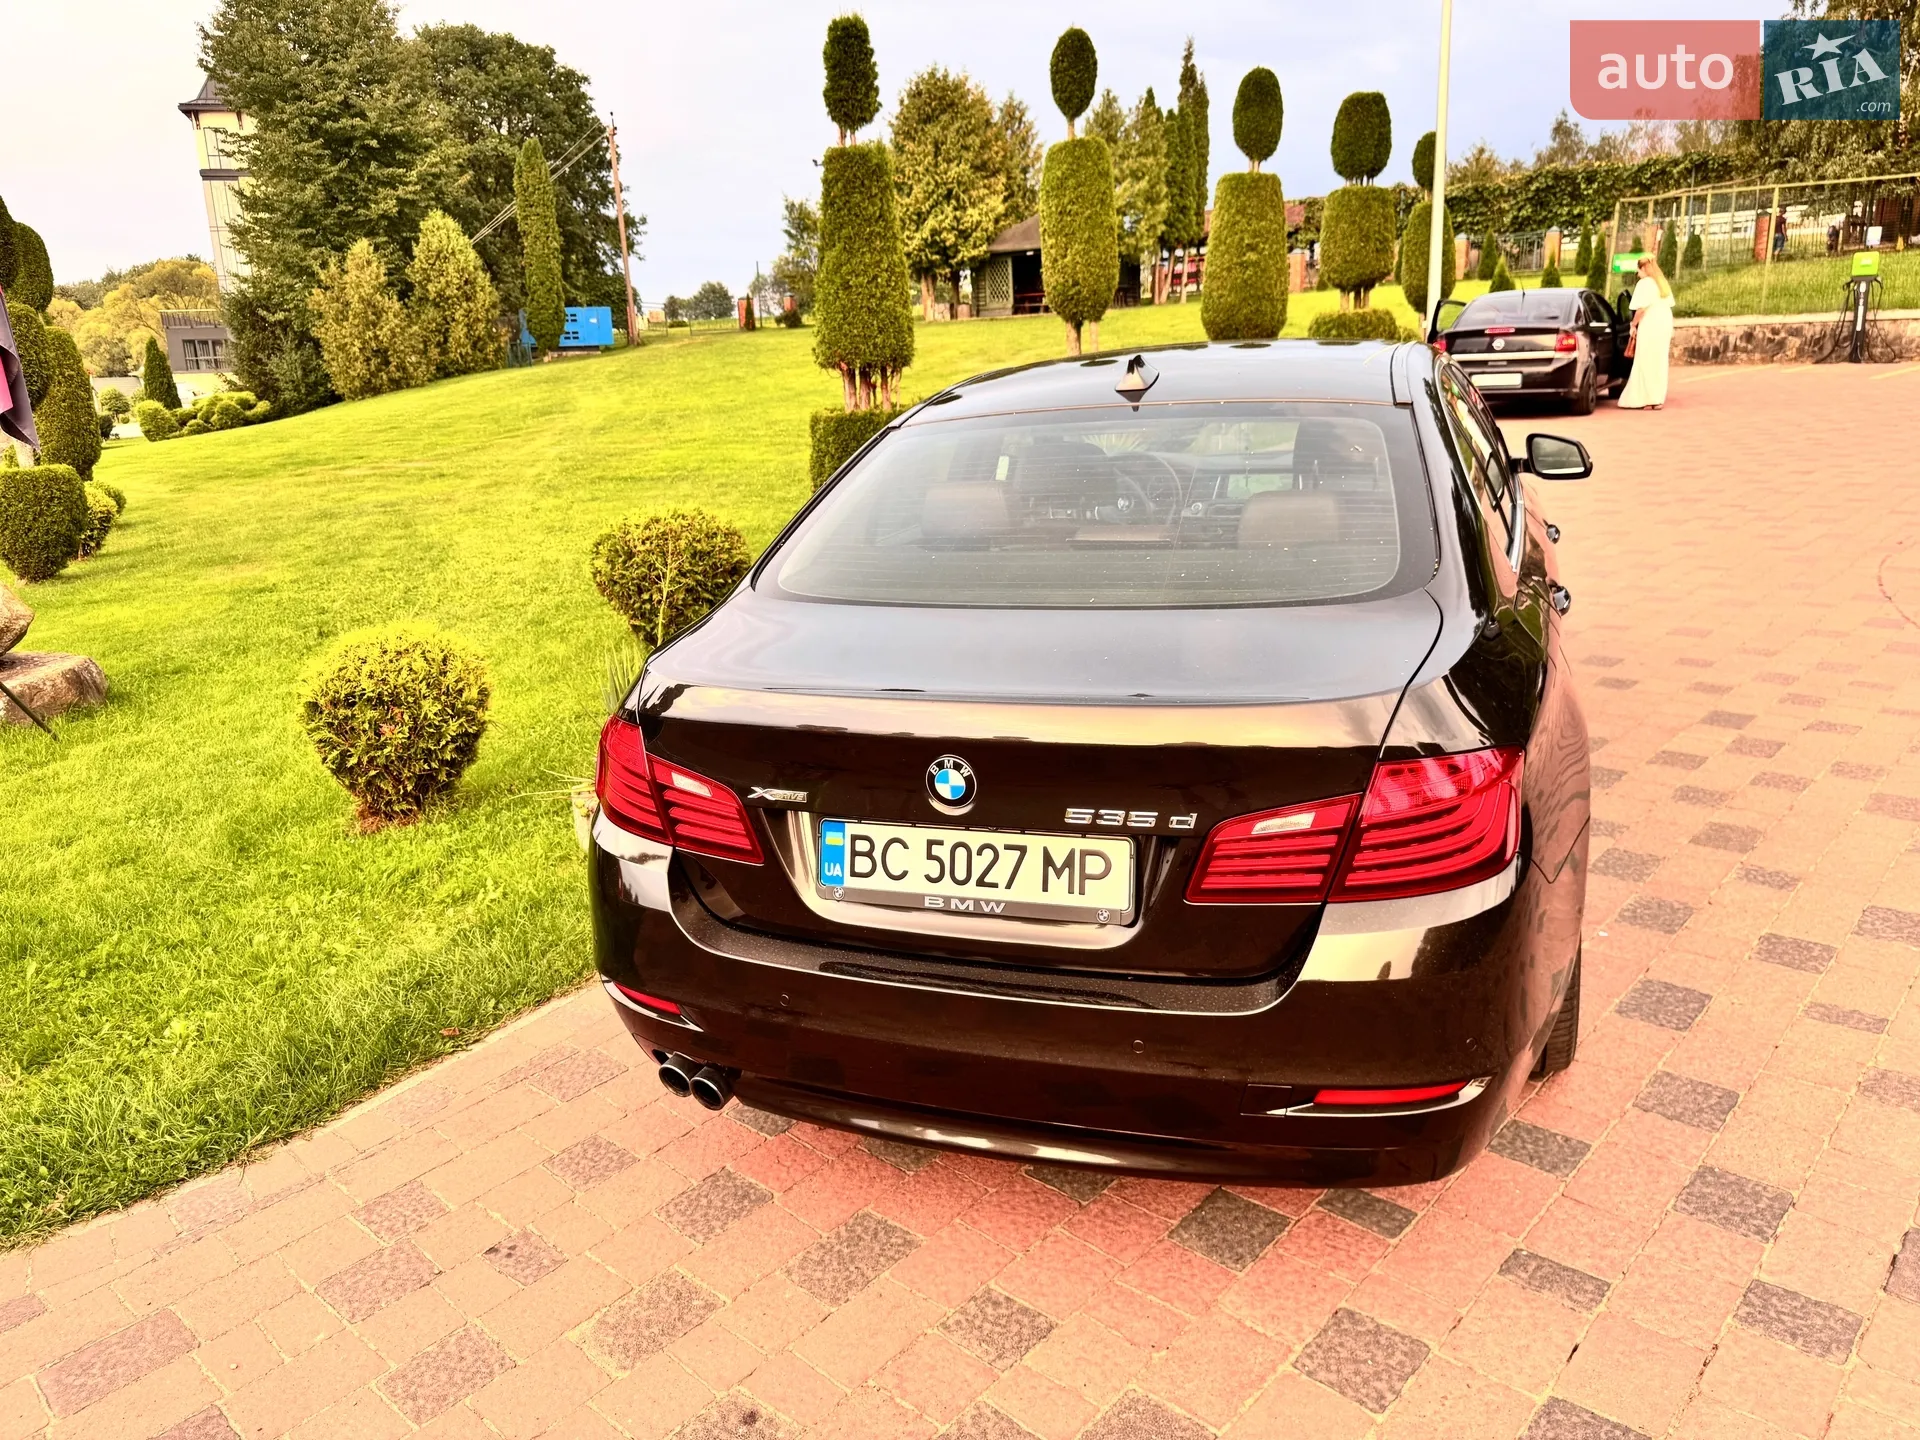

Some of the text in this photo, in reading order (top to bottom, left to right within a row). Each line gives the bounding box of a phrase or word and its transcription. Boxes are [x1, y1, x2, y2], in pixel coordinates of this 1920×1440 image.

[930, 760, 971, 777] BMW
[1064, 808, 1198, 829] 535 d
[824, 862, 843, 878] UA
[848, 834, 1112, 896] BC 5027 MP
[924, 896, 1006, 913] BMW
